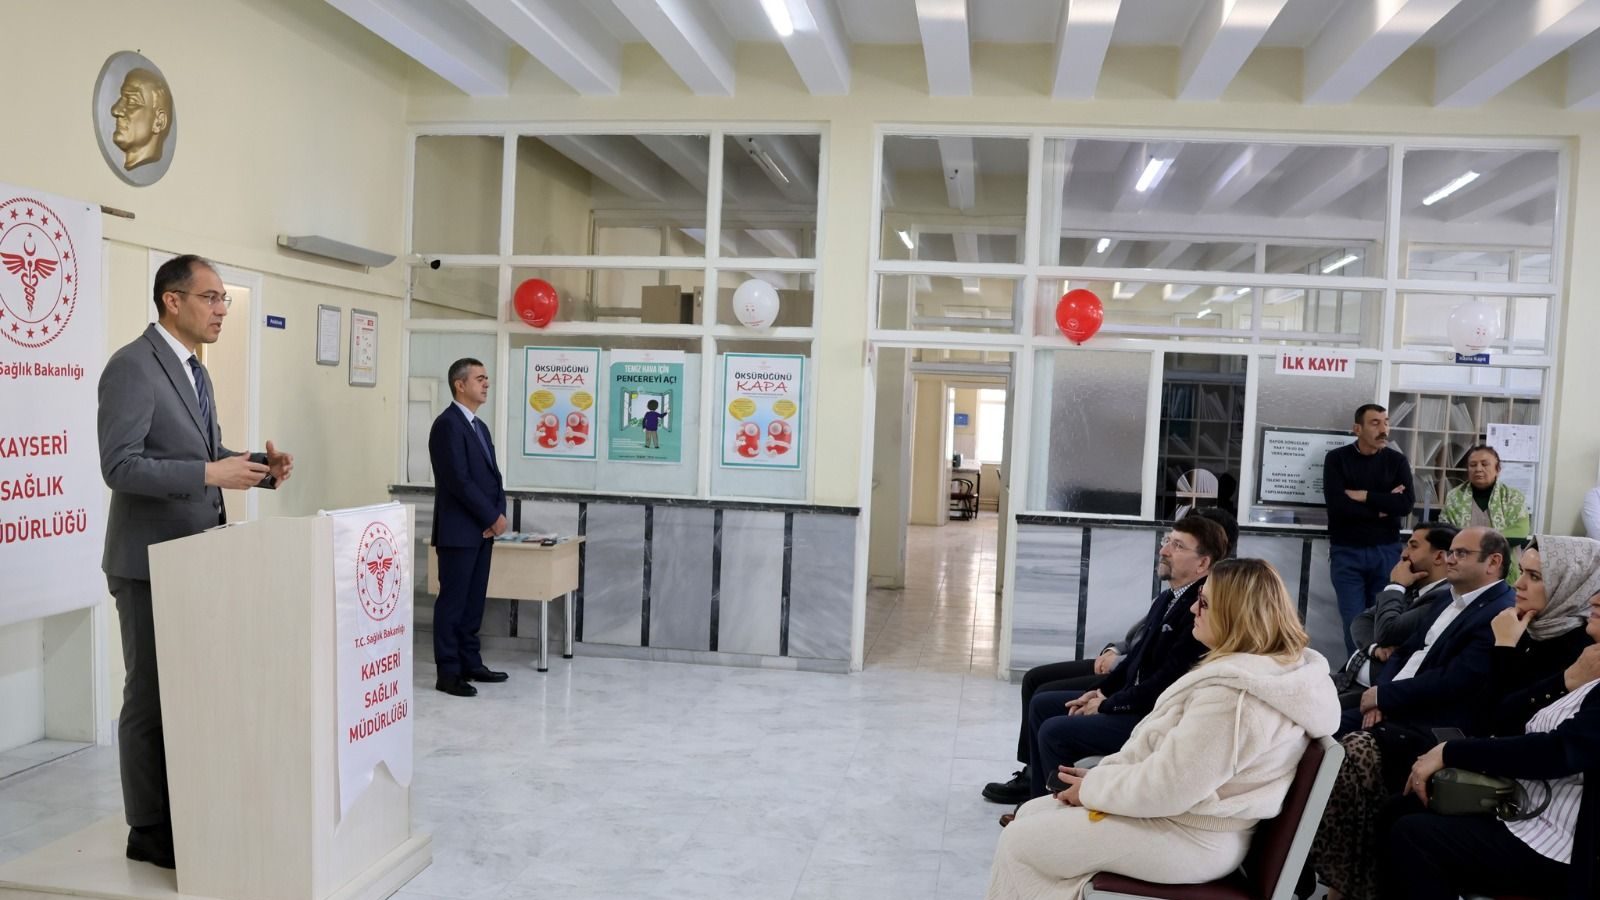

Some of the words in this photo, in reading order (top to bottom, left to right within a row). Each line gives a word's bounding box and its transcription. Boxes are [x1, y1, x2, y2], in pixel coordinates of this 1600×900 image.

[535, 364, 589, 373] ÖKSÜRÜĞÜNÜ
[642, 364, 657, 373] HAVA
[1282, 353, 1304, 369] İLK
[1308, 357, 1348, 372] KAYIT
[34, 363, 84, 380] Bakanlığı
[536, 373, 585, 385] KAPA
[616, 375, 662, 384] PENCEREYİ
[663, 376, 677, 384] AÇ!
[734, 371, 792, 381] ÖKSÜRÜĞÜNÜ
[736, 380, 788, 392] KAPA
[1, 473, 63, 501] SAĞLIK
[355, 637, 366, 648] T.C.
[366, 631, 382, 645] Sağlık
[383, 624, 405, 639] Bakanlığı
[361, 648, 401, 681] KAYSERİ
[364, 680, 399, 708] SAĞLIK
[349, 699, 408, 744] MÜDÜRLÜĞÜ
